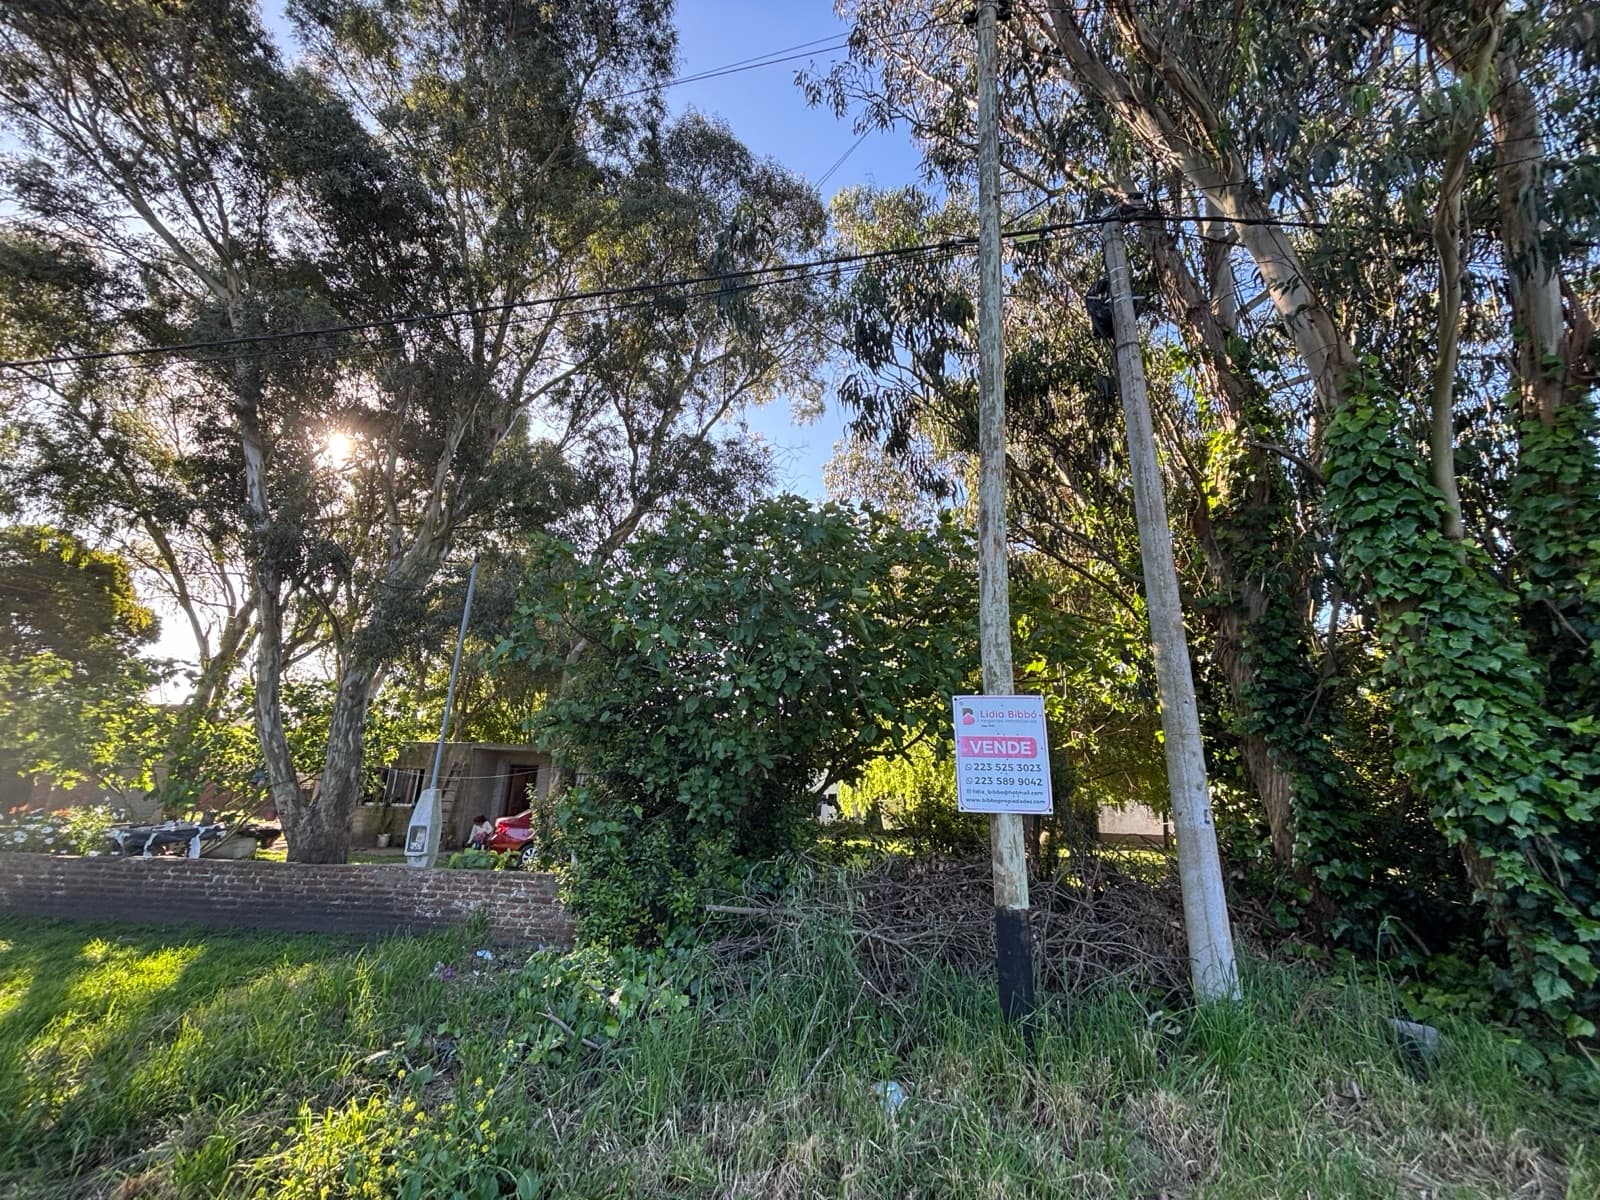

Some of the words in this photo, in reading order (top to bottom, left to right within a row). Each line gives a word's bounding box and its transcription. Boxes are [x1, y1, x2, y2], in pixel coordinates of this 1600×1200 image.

[980, 711, 1004, 719] Lidia
[969, 740, 1032, 755] VENDE
[974, 762, 992, 771] 223
[995, 764, 1014, 772] 525
[1017, 764, 1042, 772] 3023
[975, 777, 993, 785] 223
[996, 777, 1015, 786] 589
[1018, 778, 1043, 786] 9042
